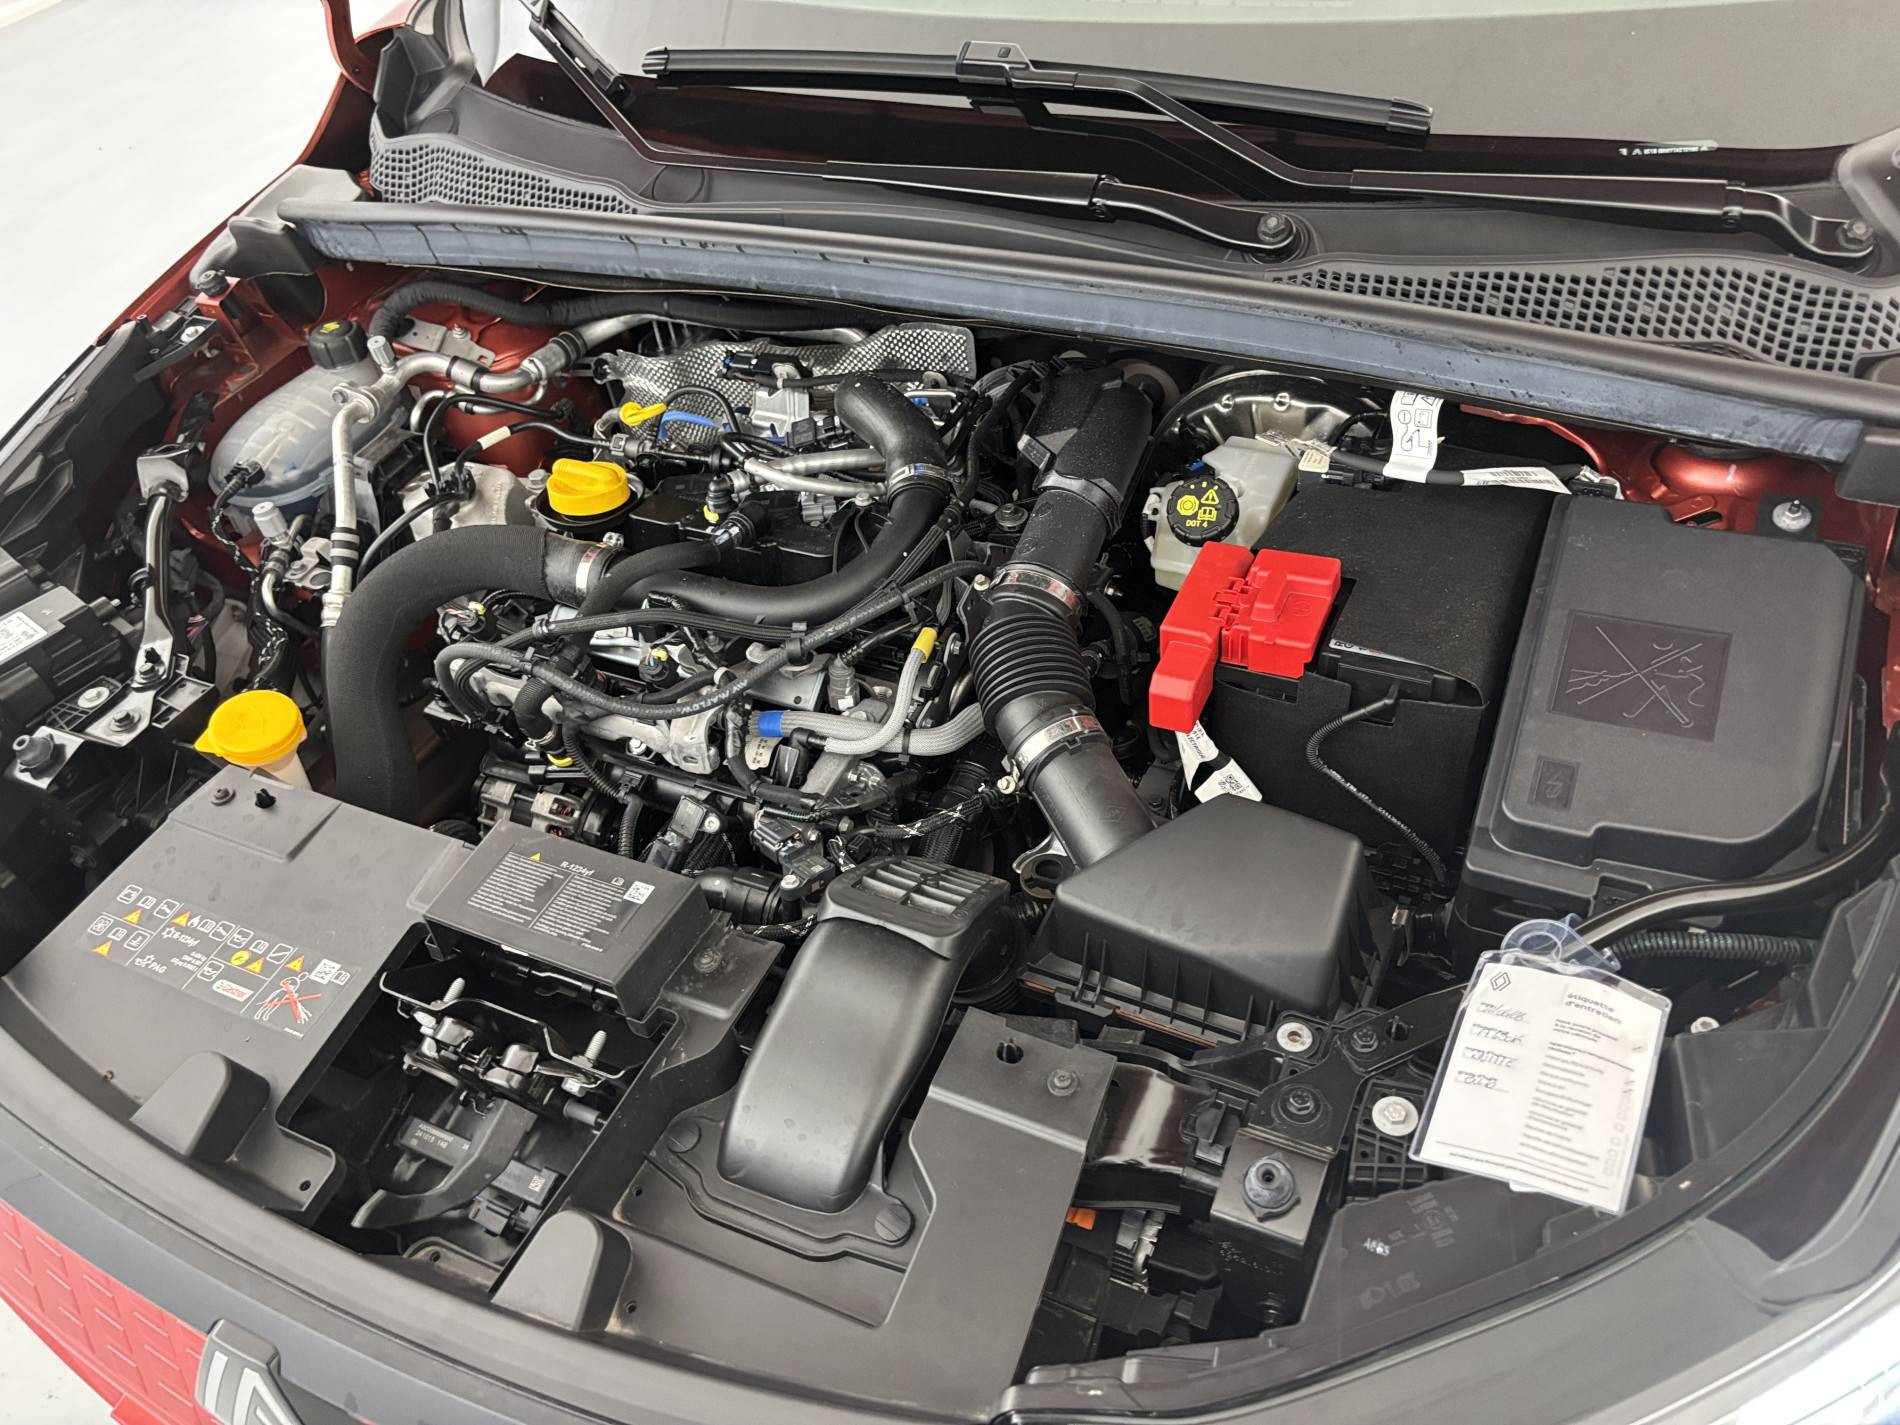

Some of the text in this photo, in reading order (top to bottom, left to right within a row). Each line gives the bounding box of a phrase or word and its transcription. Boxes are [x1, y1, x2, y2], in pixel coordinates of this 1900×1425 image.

[1185, 519, 1208, 528] DOT 4
[148, 961, 168, 973] PAG
